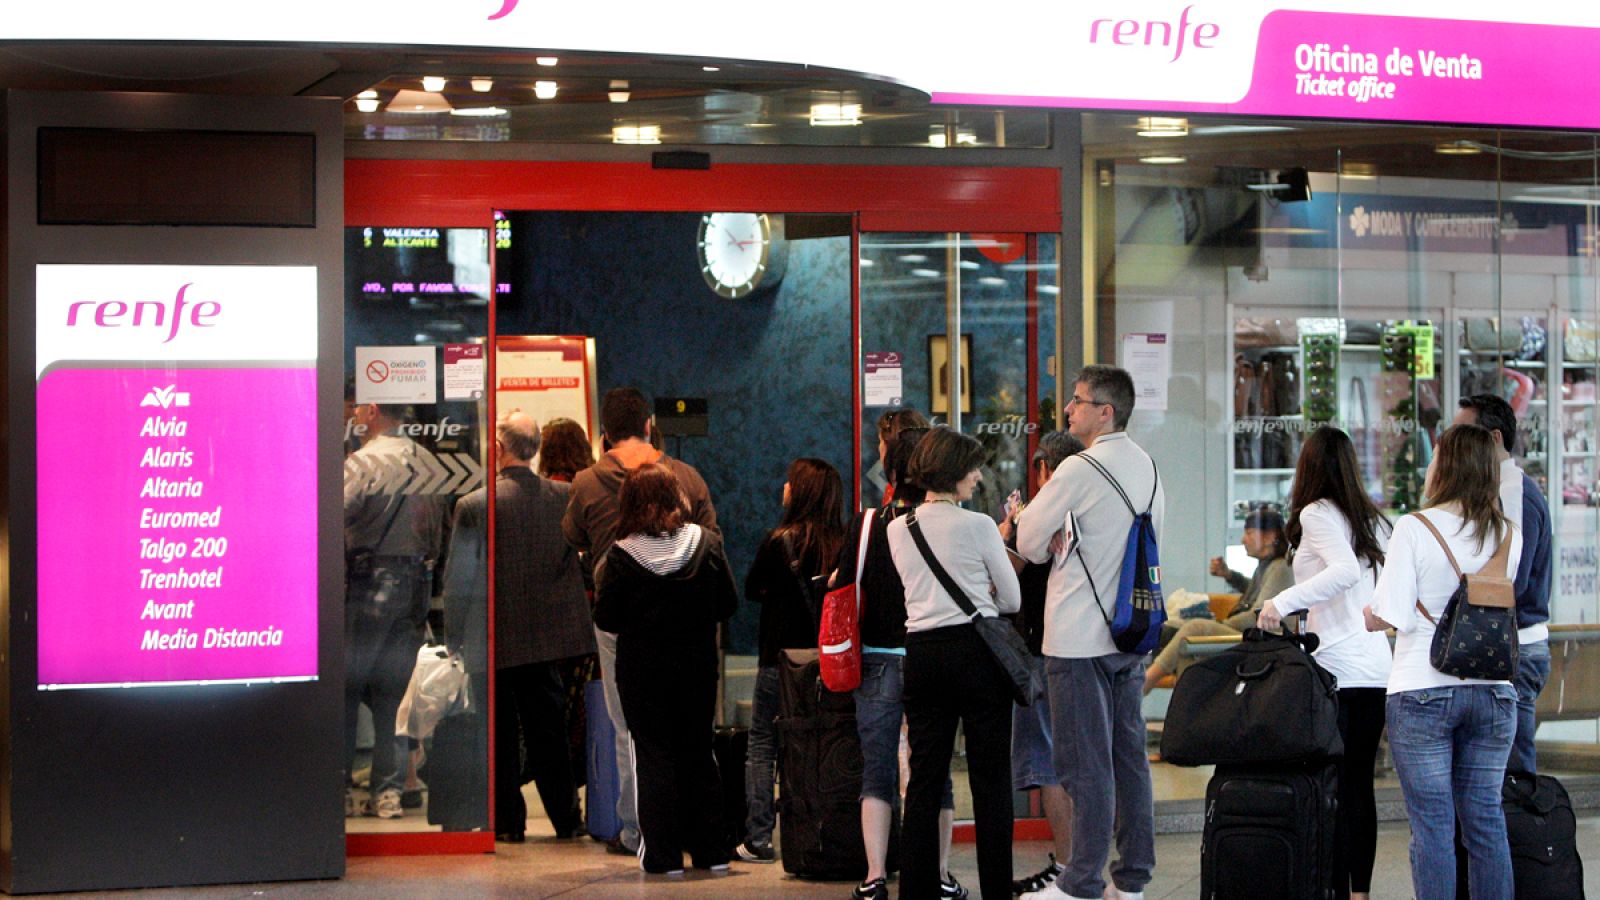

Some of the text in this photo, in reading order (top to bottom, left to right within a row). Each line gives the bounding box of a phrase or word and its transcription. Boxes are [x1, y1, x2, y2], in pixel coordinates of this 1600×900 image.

[1088, 4, 1221, 64] renfe
[1294, 43, 1483, 80] Oficina de Venta
[1294, 73, 1396, 103] Ticket office
[383, 228, 440, 238] VALENCIA
[1370, 210, 1402, 236] MODA
[1403, 211, 1413, 236] Y
[383, 238, 439, 248] ALICANTE
[391, 283, 415, 293] POR
[419, 283, 454, 293] FAVOR
[65, 282, 222, 343] renfe
[390, 375, 427, 383] FUMAR
[502, 377, 576, 387] VENTA DE BILLETES
[676, 400, 686, 413] 9
[139, 415, 188, 437] Alvia
[397, 416, 462, 442] renfe
[976, 416, 1038, 441] renfe
[139, 446, 194, 468] Alaris
[139, 476, 204, 498] Altaria
[139, 505, 222, 529] Euromed
[139, 536, 228, 563] Talgo 200
[139, 566, 223, 589] Trenhotel
[1560, 573, 1573, 596] DE
[140, 599, 195, 620] Avant
[140, 624, 284, 650] Media Distancia
